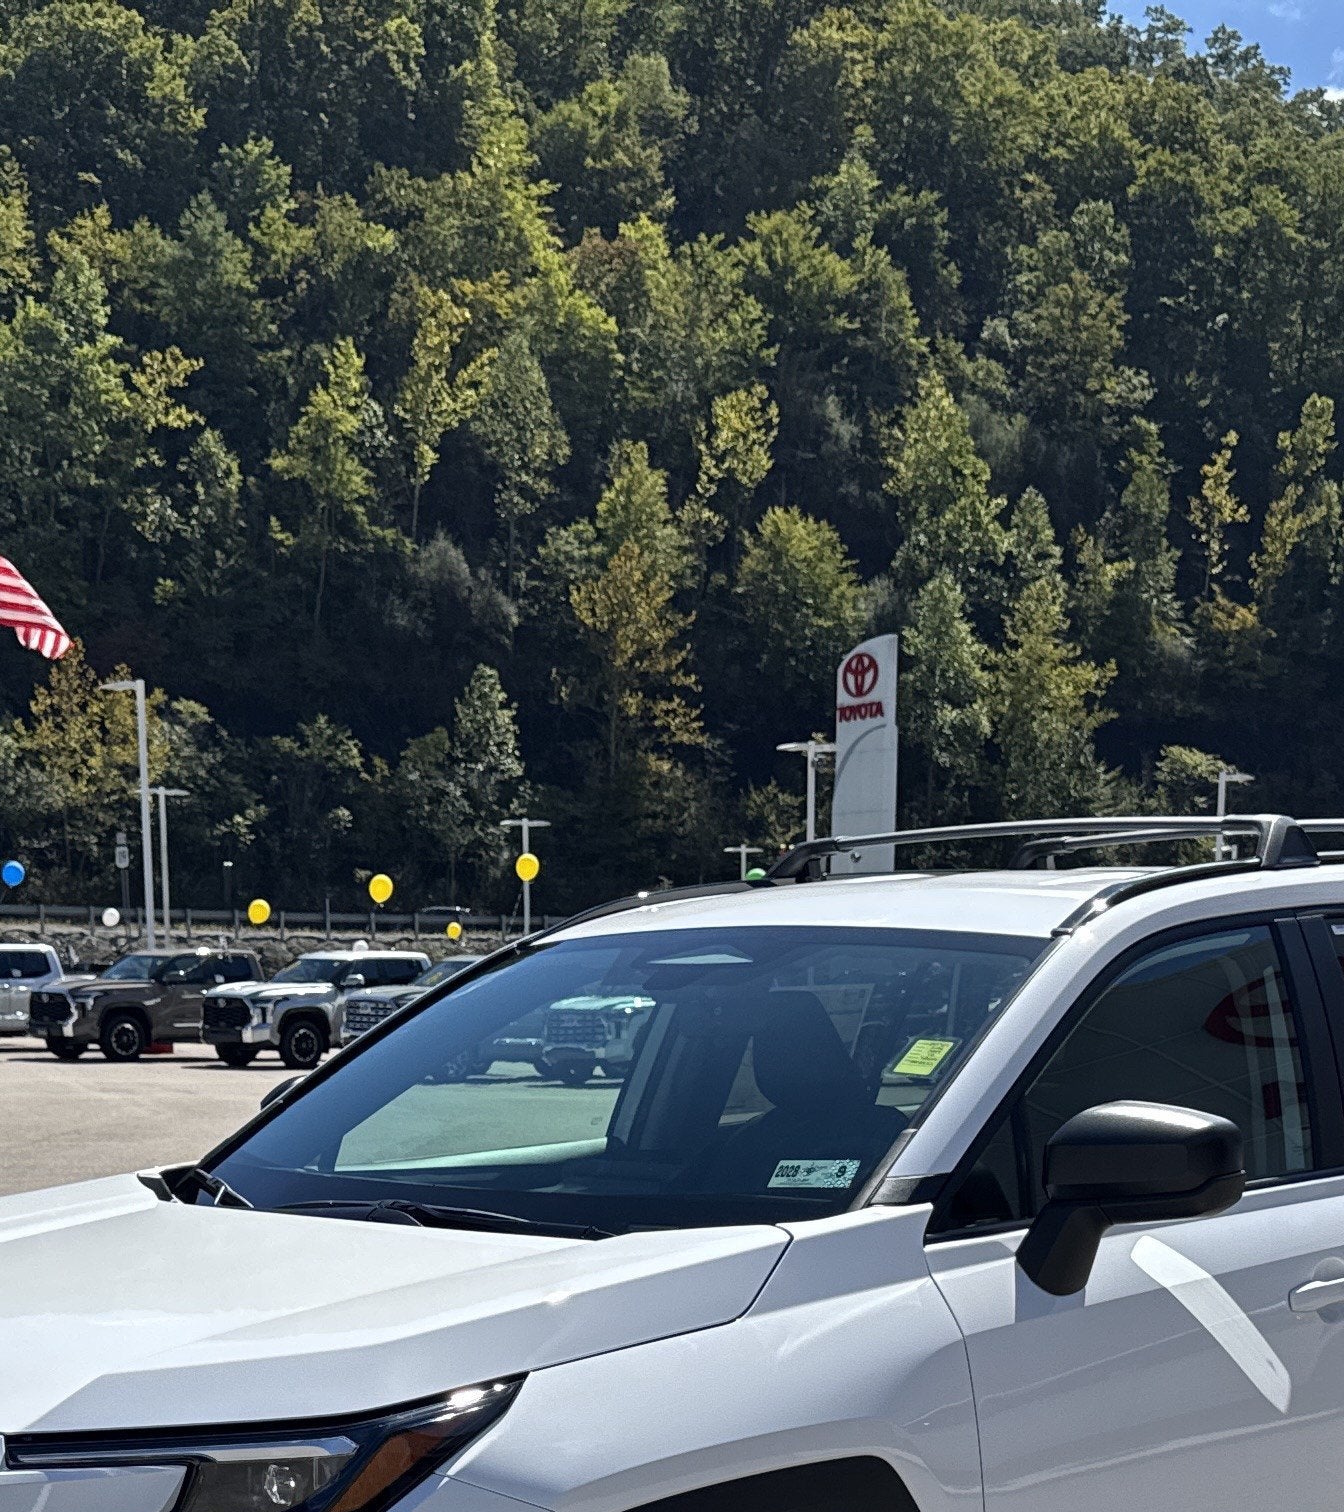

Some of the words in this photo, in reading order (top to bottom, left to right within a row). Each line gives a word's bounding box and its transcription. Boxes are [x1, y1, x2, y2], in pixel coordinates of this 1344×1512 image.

[837, 701, 885, 723] TOYOTA
[774, 1164, 802, 1178] 2028
[835, 1165, 849, 1179] 9
